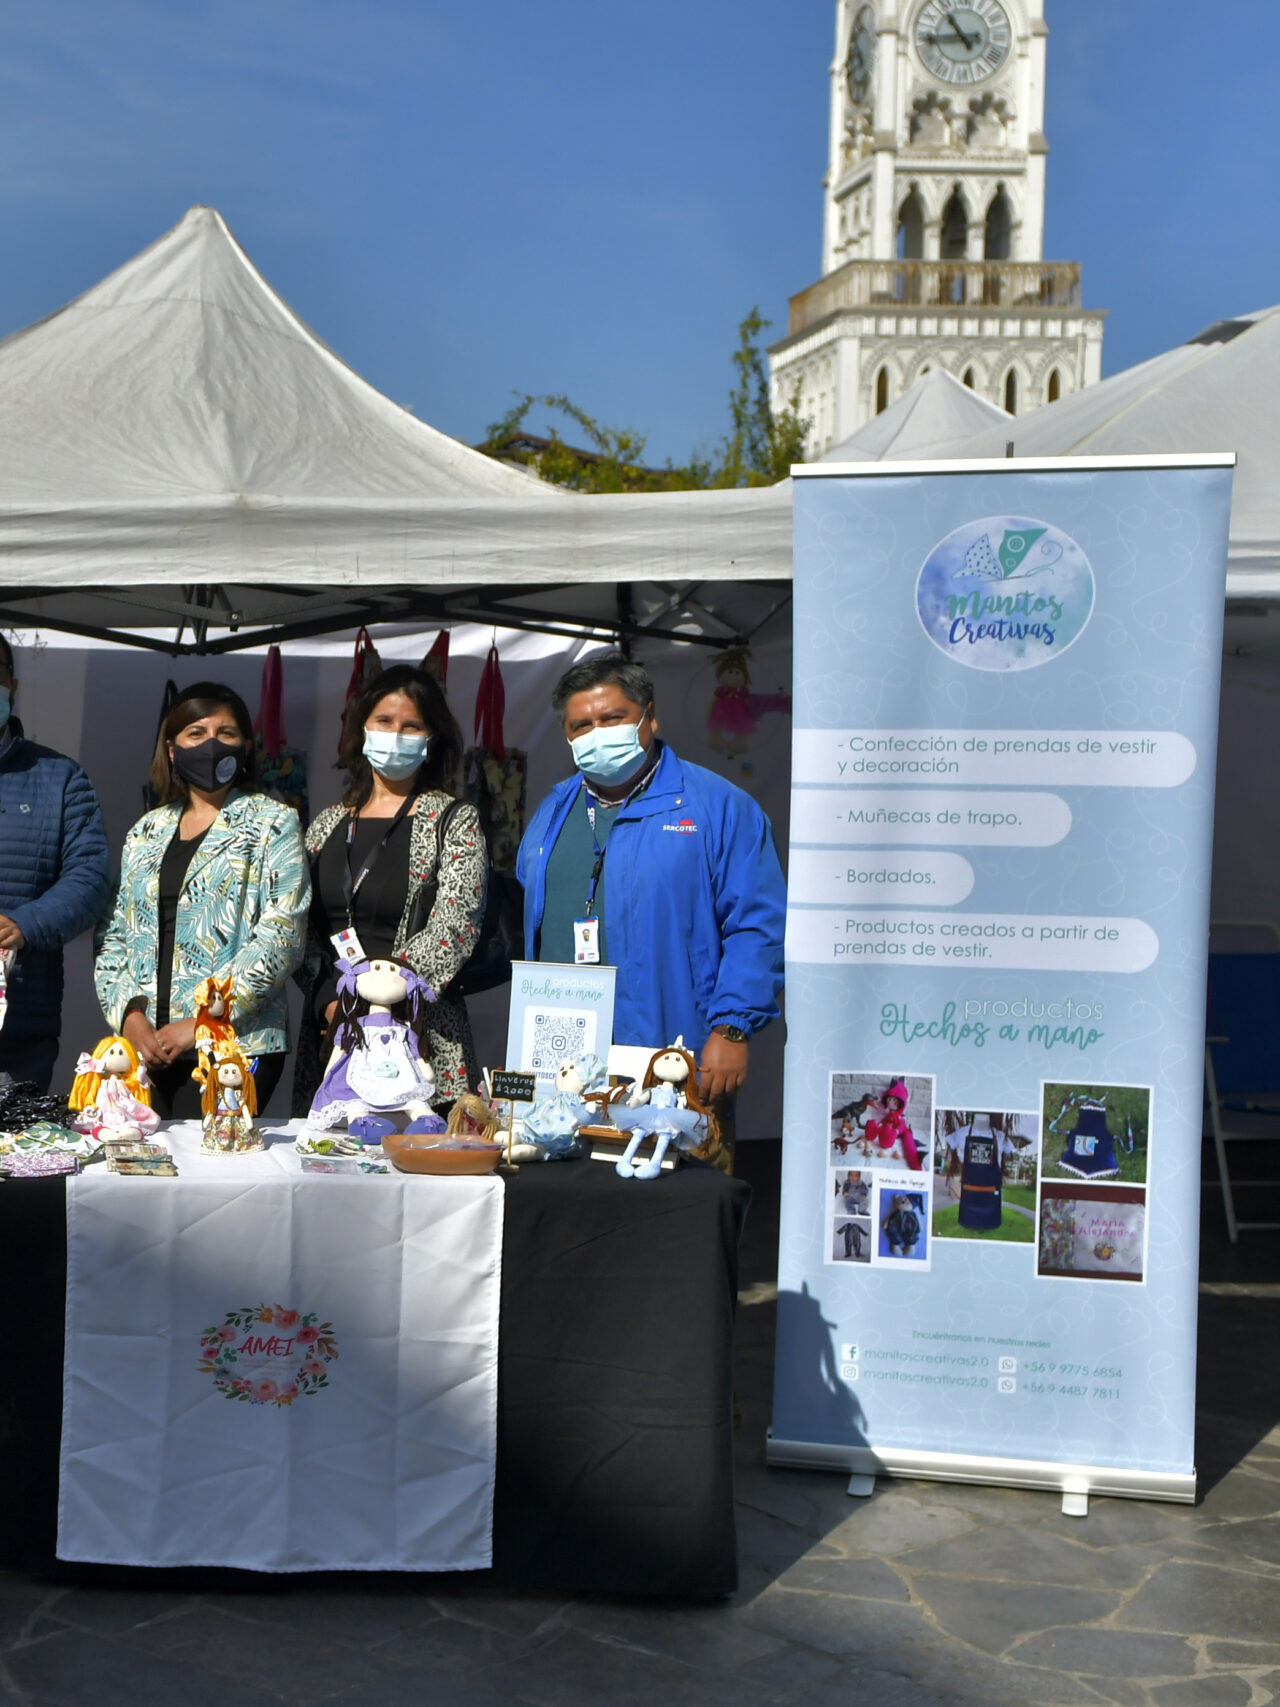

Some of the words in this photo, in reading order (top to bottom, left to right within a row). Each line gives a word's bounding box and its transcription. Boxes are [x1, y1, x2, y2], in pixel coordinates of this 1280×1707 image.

[944, 590, 1064, 620] Manitos
[948, 616, 1056, 646] Creativas
[849, 735, 958, 755] Confección
[962, 737, 988, 754] de
[994, 737, 1071, 758] prendas
[1076, 737, 1103, 754] de
[1108, 738, 1157, 755] vestir
[838, 762, 847, 775] y
[852, 755, 959, 774] decoración
[847, 807, 931, 826] Muñecas
[936, 808, 961, 826] de
[967, 809, 1023, 829] trapo.
[846, 867, 937, 886] Bordados.
[845, 918, 935, 936] Productos
[940, 920, 1016, 938] creados
[1021, 926, 1034, 938] a
[1039, 923, 1088, 943] partir
[1094, 924, 1120, 941] de
[833, 940, 906, 959] prendas
[911, 941, 937, 957] de
[942, 942, 993, 960] vestir.
[521, 979, 562, 999] Hechos
[576, 990, 604, 1001] mano
[963, 997, 1104, 1021] productos
[879, 1001, 991, 1048] Hechos
[999, 1021, 1019, 1042] a
[1027, 1021, 1105, 1051] mano
[974, 1335, 985, 1343] en
[1025, 1339, 1052, 1349] redes
[1022, 1361, 1045, 1373] +56
[1048, 1362, 1057, 1374] 9
[1059, 1363, 1090, 1376] 9775
[1092, 1366, 1123, 1379] 6854
[1022, 1382, 1045, 1393] +56
[1048, 1383, 1056, 1394] 9
[1058, 1384, 1088, 1396] 4487
[1092, 1387, 1120, 1400] 7811
